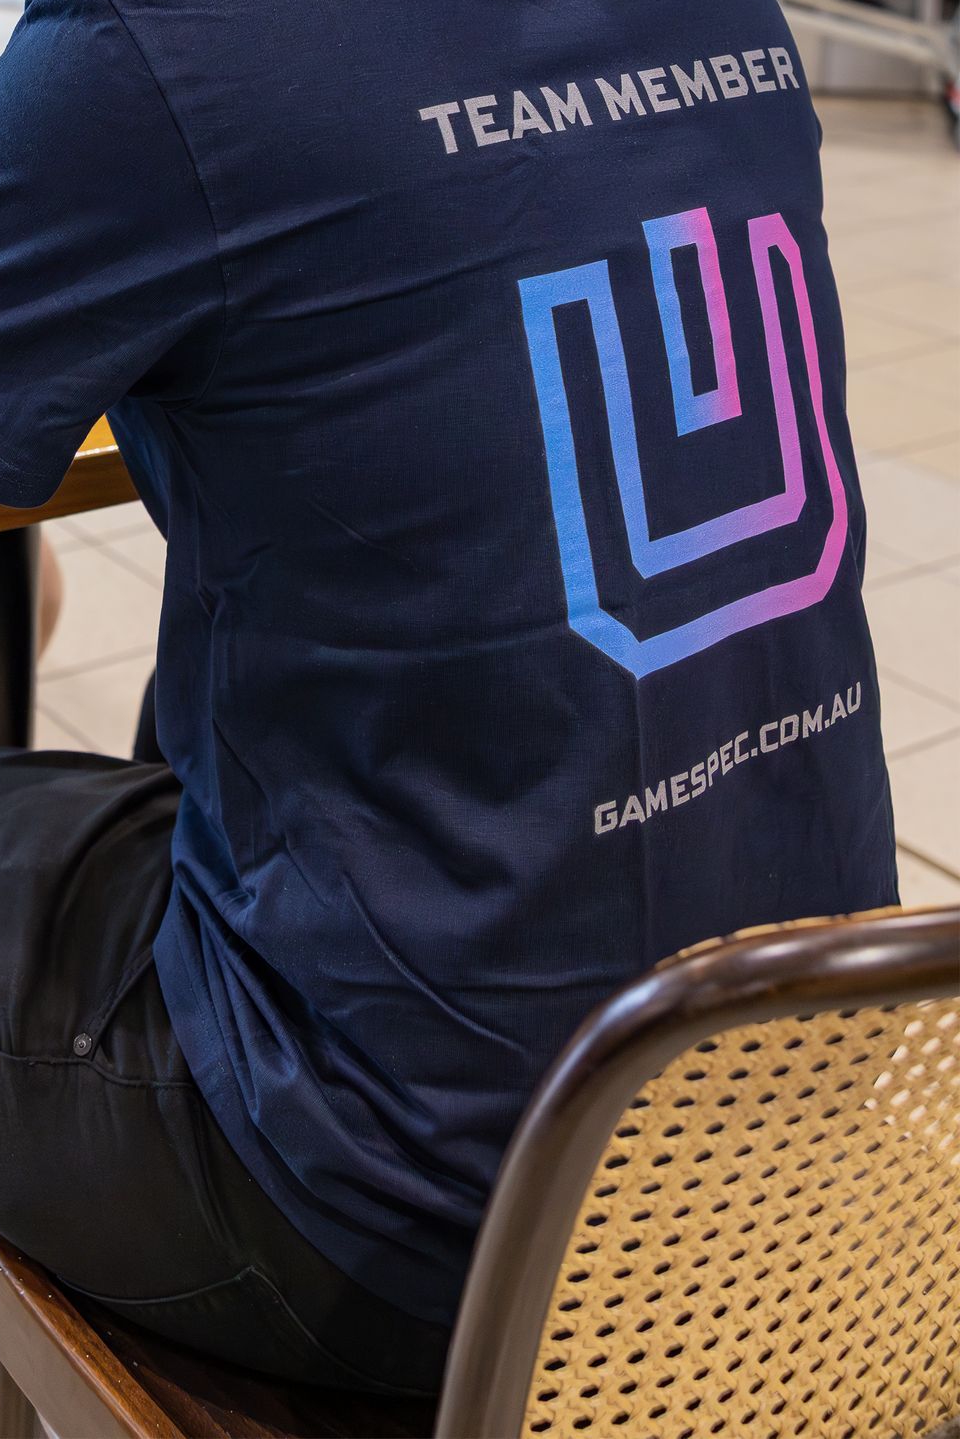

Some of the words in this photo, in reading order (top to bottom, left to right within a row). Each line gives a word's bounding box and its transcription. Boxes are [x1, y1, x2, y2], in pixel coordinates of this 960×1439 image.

[418, 82, 593, 155] TEAM
[594, 46, 800, 122] MEMBER
[594, 681, 862, 835] GAMESPEC.COM.AU
